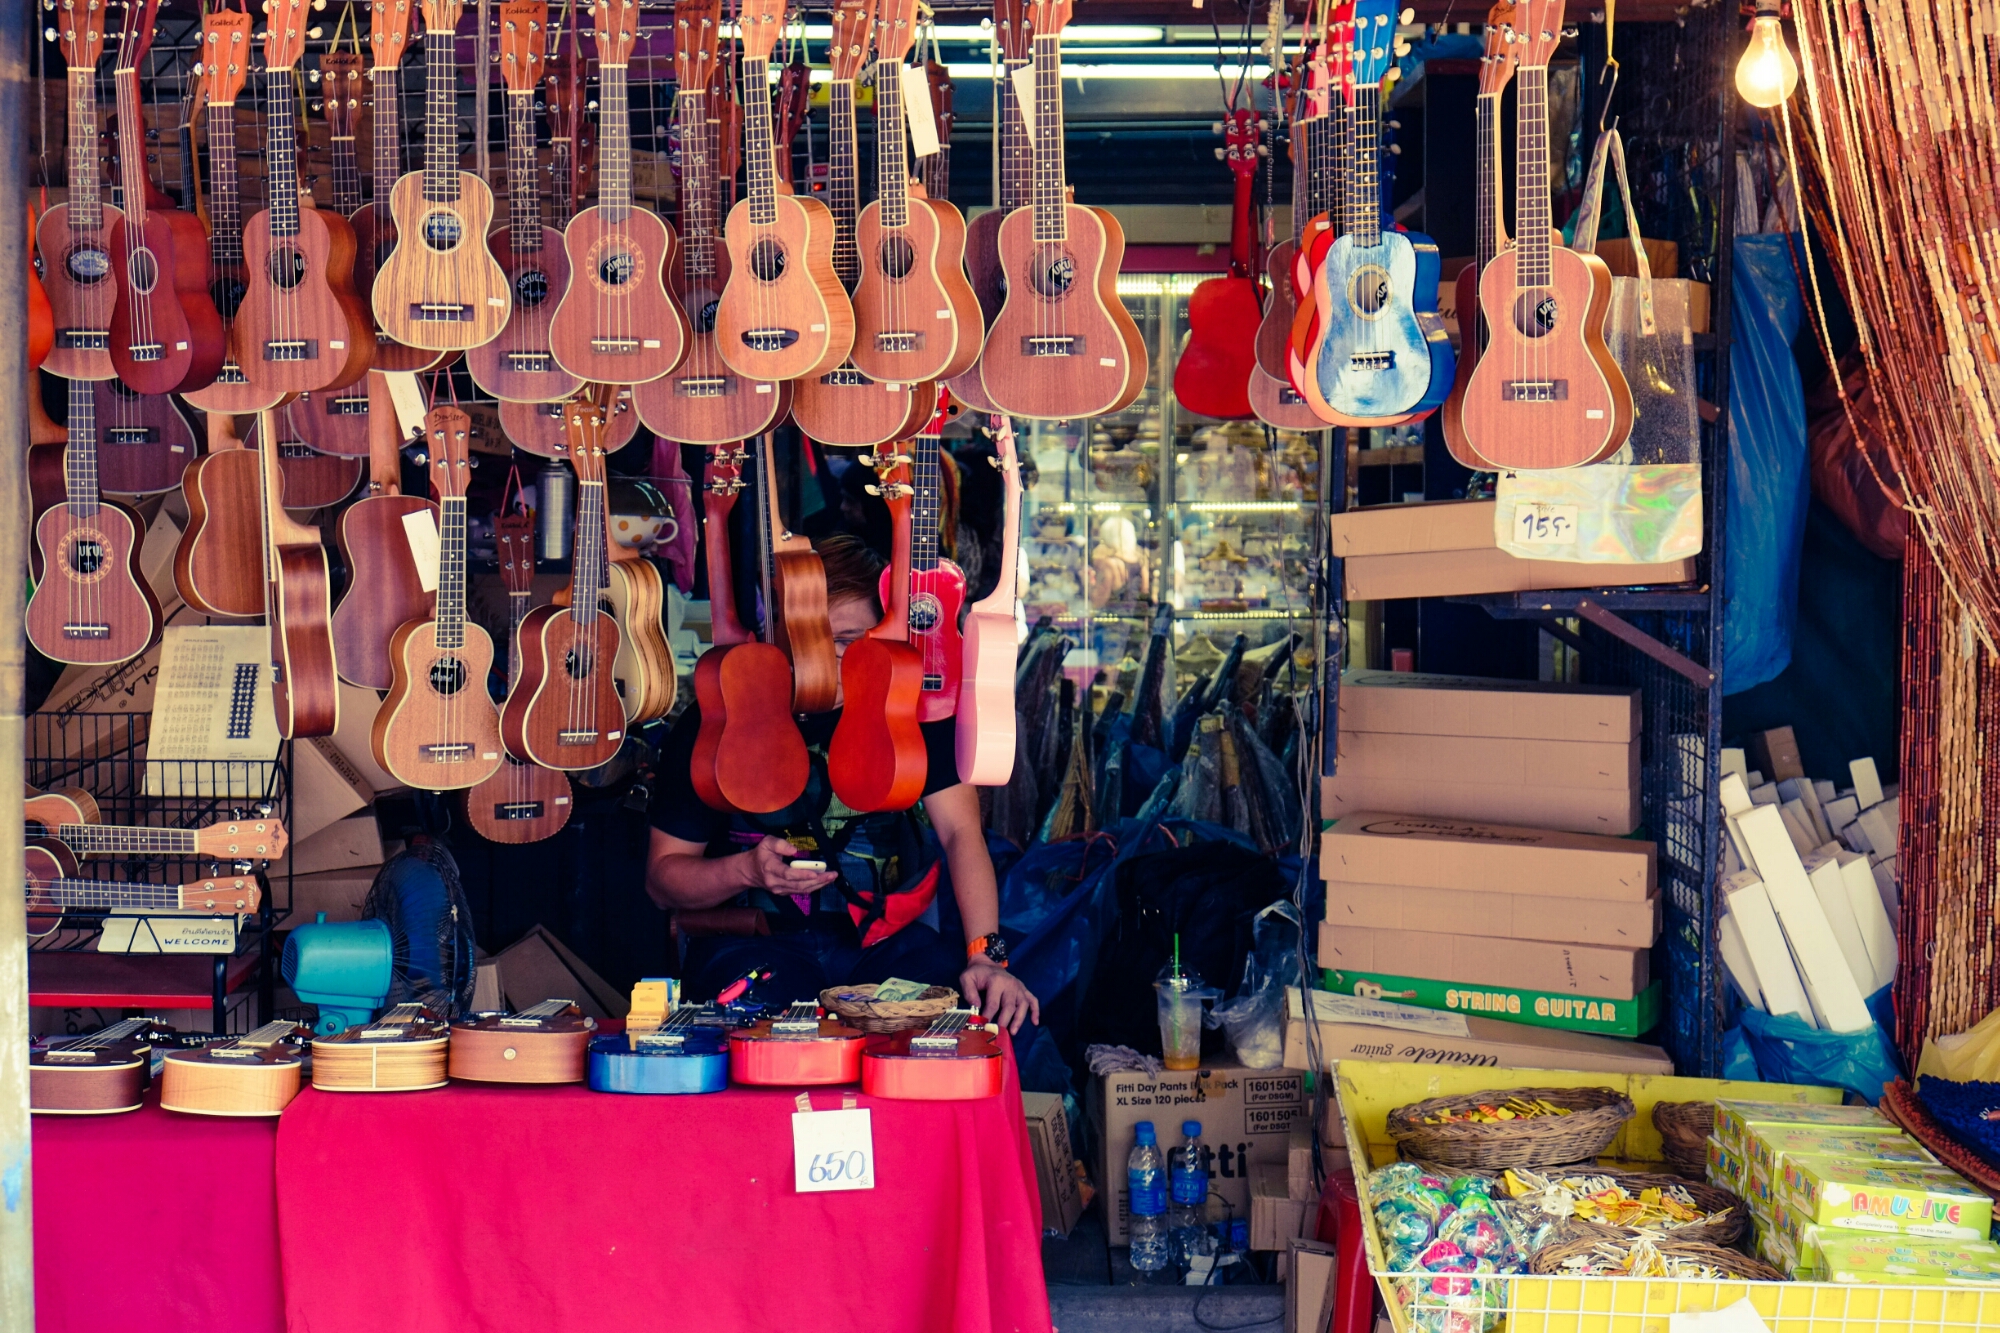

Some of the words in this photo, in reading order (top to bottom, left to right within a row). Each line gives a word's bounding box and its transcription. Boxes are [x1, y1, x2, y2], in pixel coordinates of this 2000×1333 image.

[164, 938, 230, 946] WELCOME
[1445, 988, 1522, 1014] STRING
[1534, 996, 1617, 1022] GUITAR
[1350, 1043, 1394, 1059] guitar
[1116, 1083, 1135, 1093] Fitti
[1137, 1082, 1157, 1094] Day
[1159, 1081, 1188, 1092] Pants
[1214, 1079, 1239, 1089] Pack
[1248, 1080, 1298, 1092] 1601504
[1116, 1097, 1129, 1106] XL
[1131, 1096, 1152, 1106] Size
[1154, 1095, 1172, 1104] 120
[1251, 1093, 1267, 1102] (For
[1268, 1092, 1294, 1101] DSGM)
[1253, 1122, 1268, 1132] (For
[808, 1150, 866, 1183] 650
[1852, 1191, 1961, 1225] AMUSIVE
